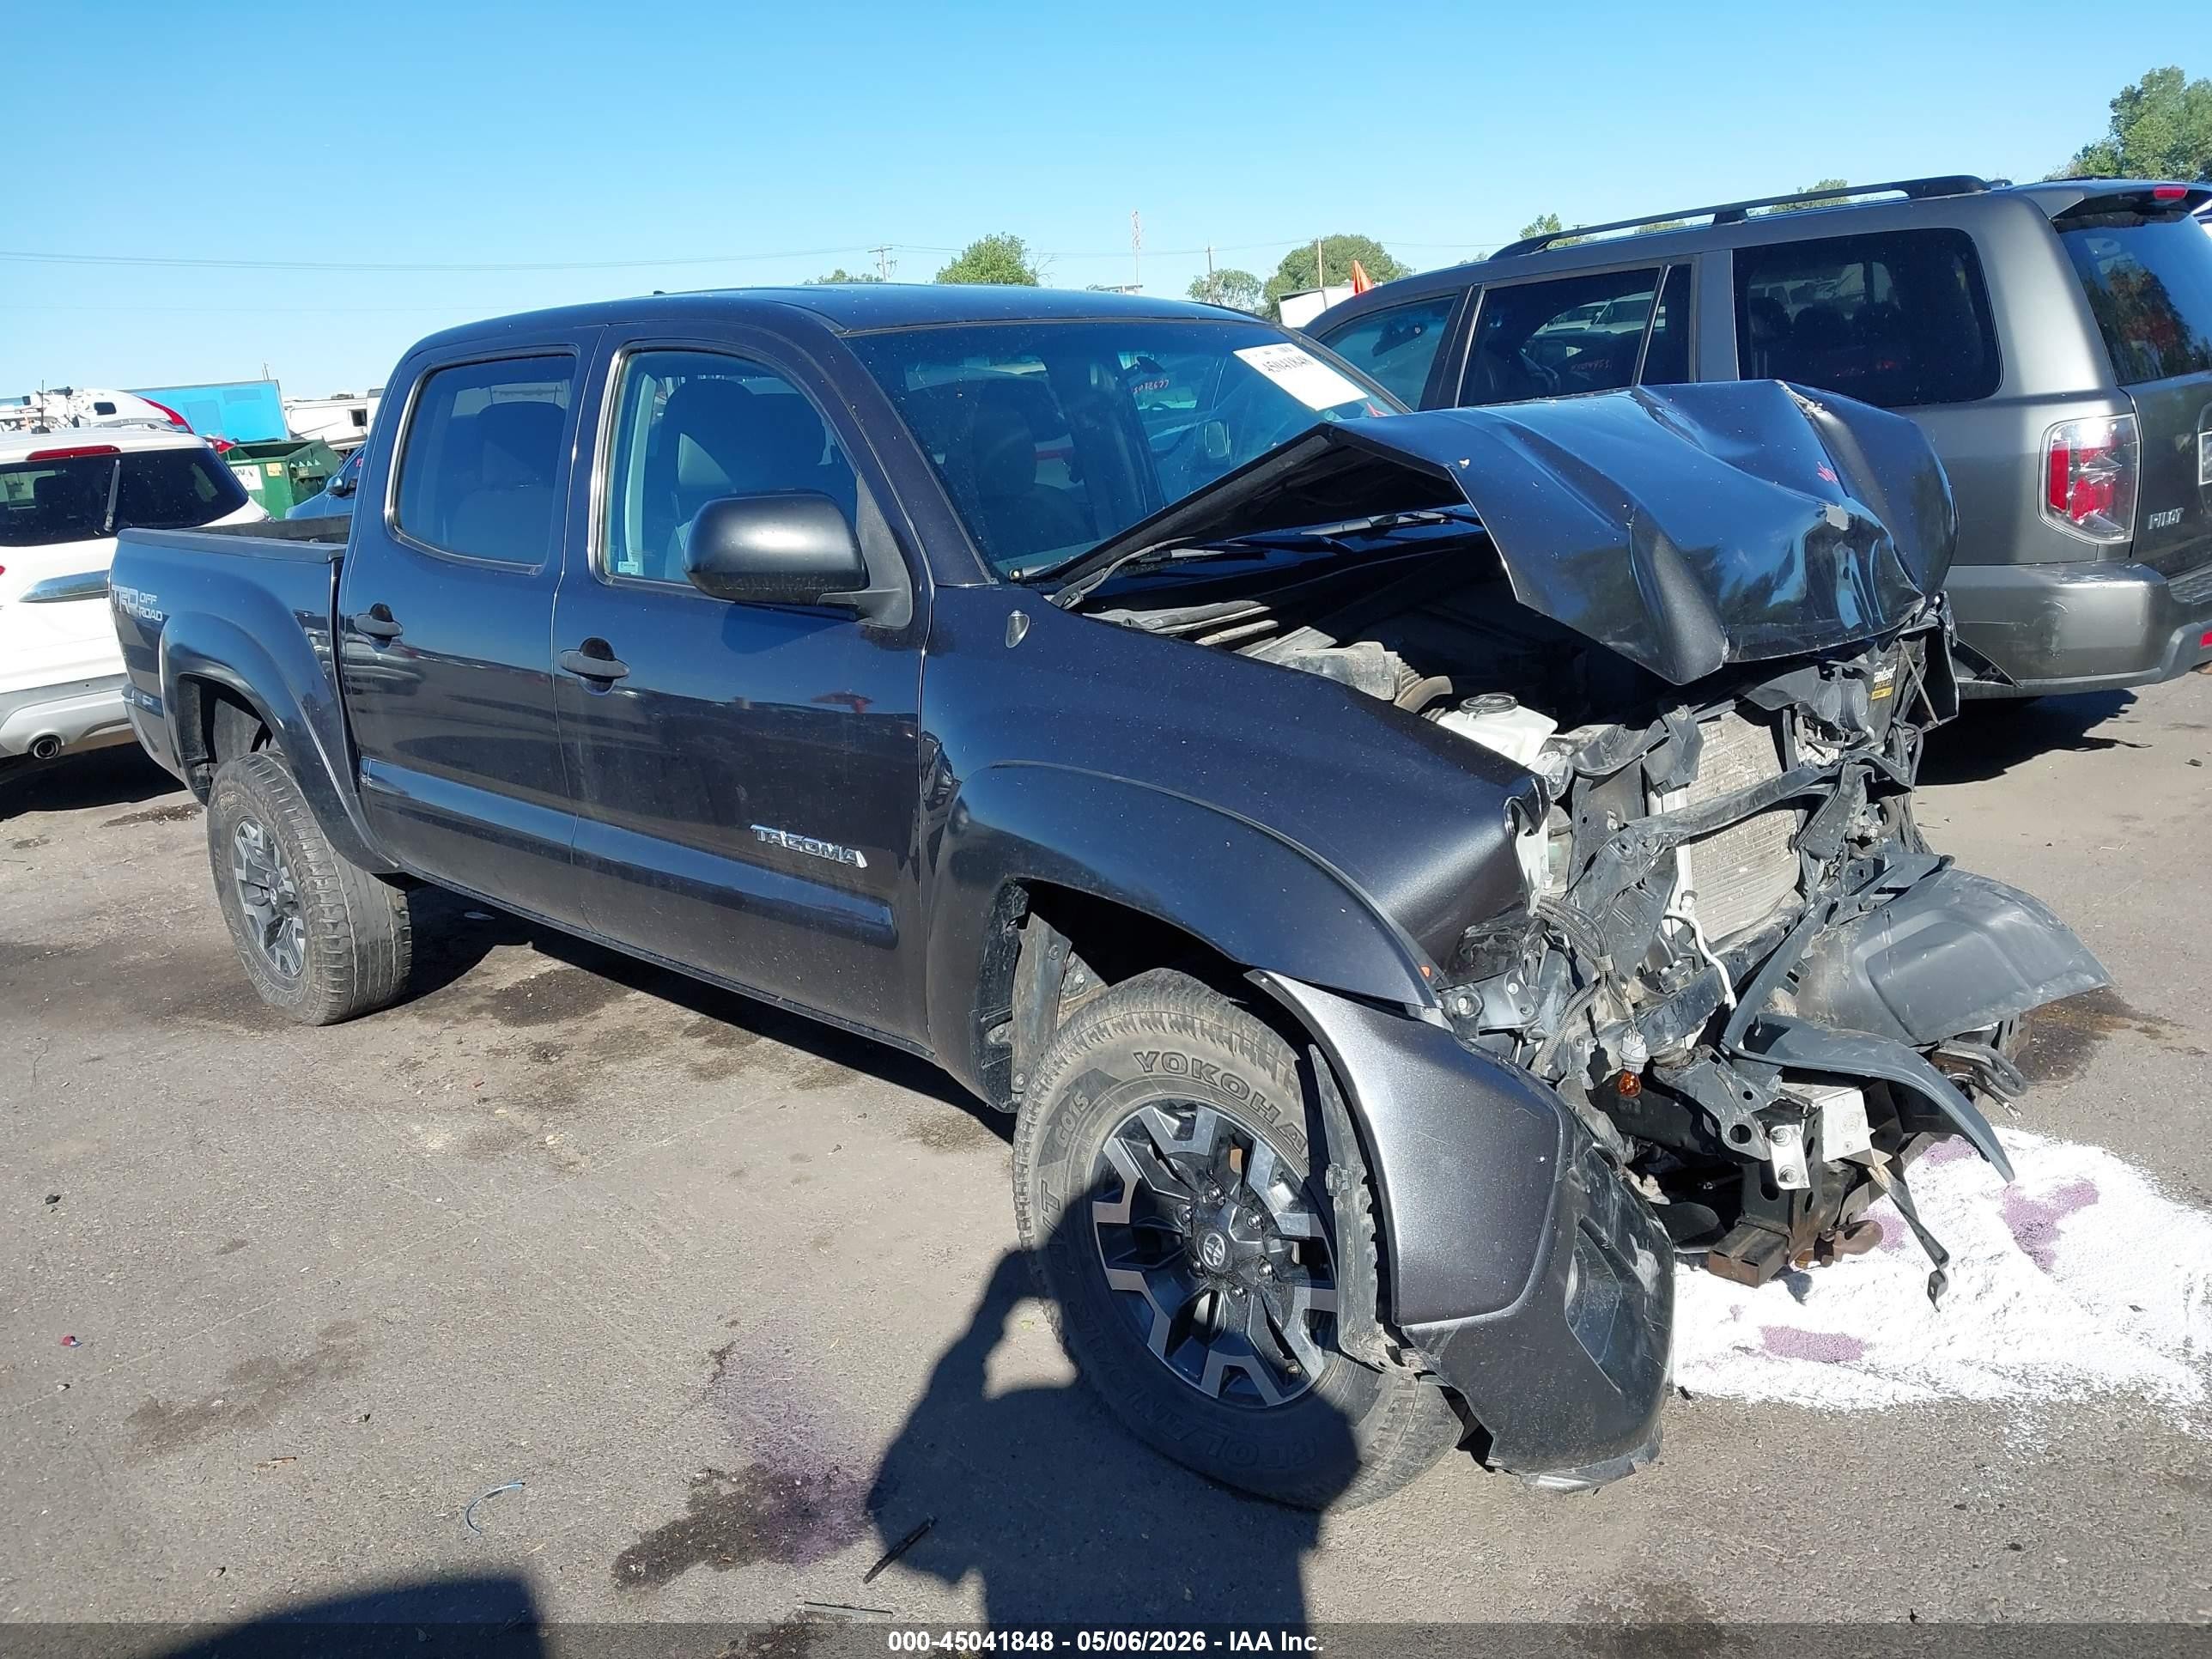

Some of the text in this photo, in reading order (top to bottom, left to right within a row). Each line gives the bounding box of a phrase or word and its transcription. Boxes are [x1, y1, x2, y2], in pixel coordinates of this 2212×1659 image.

[2148, 507, 2185, 530] PILOT
[112, 584, 138, 614] TRD
[138, 605, 162, 621] ROAD
[139, 592, 157, 605] OFF
[750, 823, 867, 868] TACOMA
[1056, 1091, 1091, 1149] G015
[1133, 1050, 1310, 1165] YOKOHA
